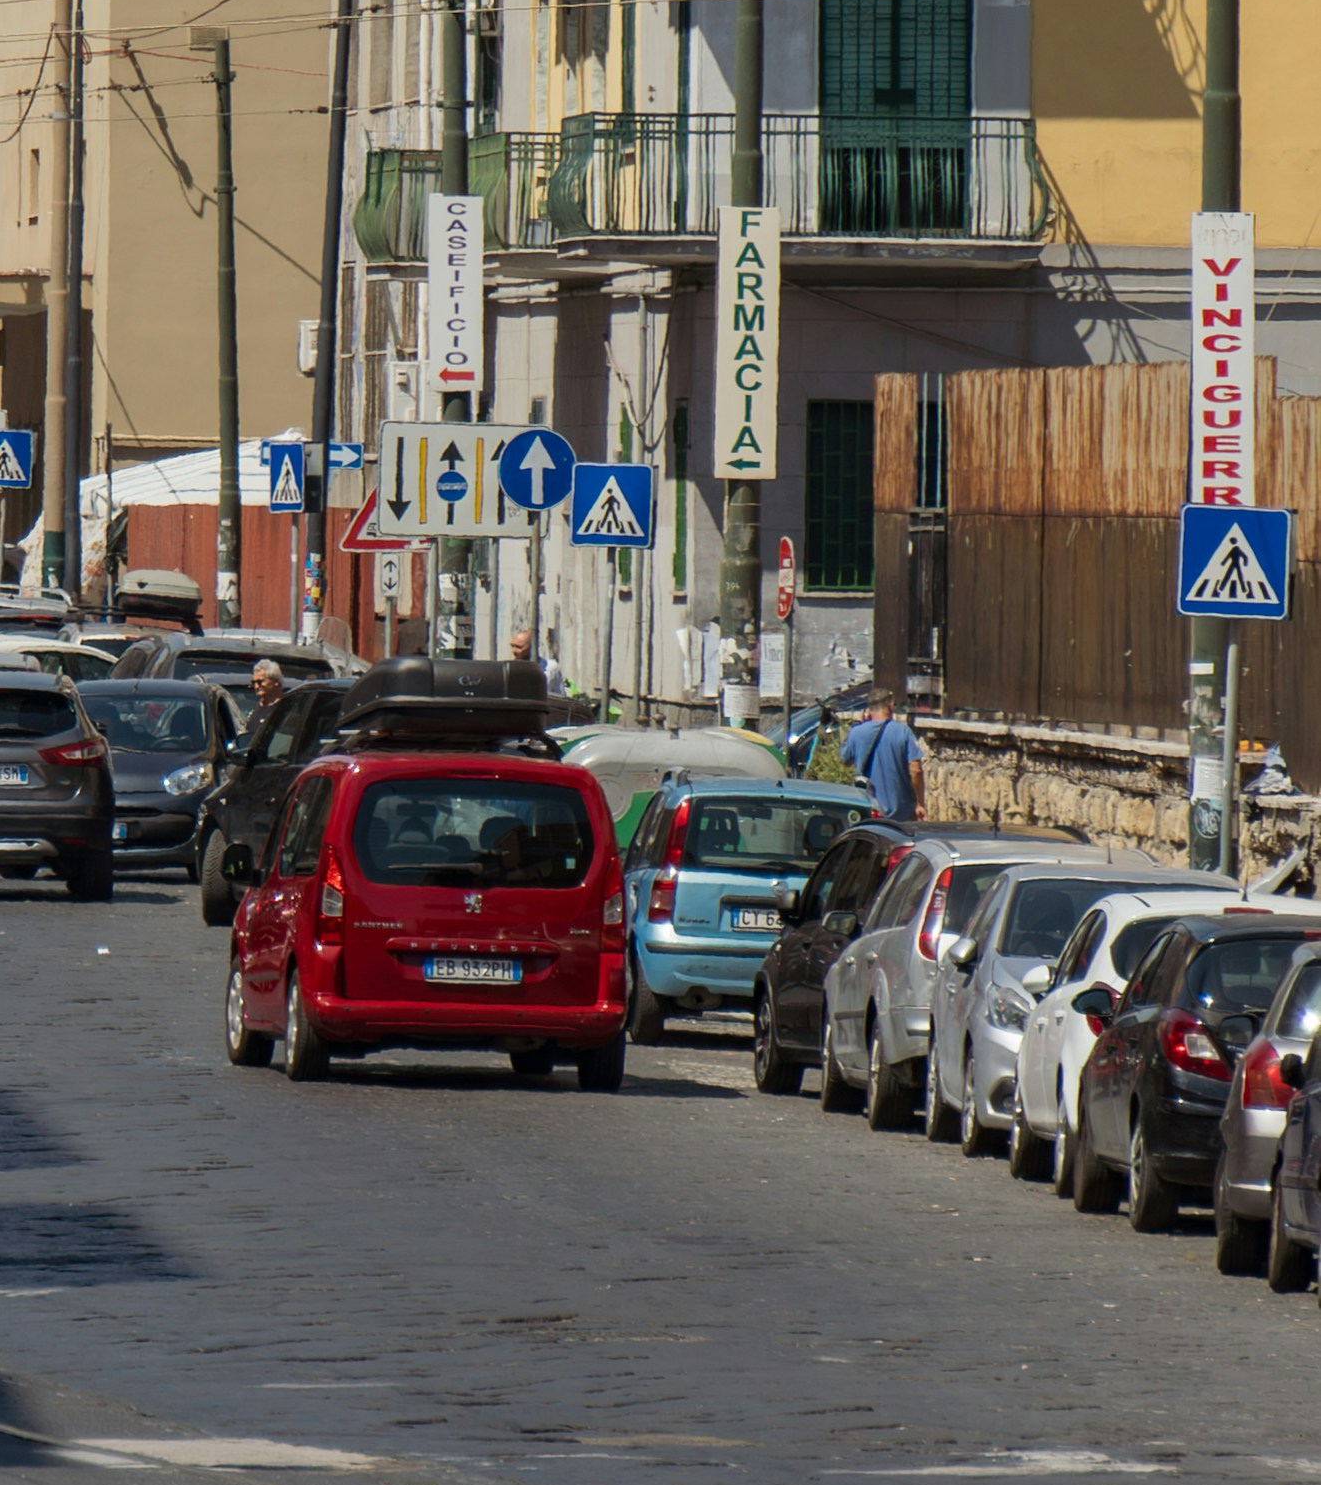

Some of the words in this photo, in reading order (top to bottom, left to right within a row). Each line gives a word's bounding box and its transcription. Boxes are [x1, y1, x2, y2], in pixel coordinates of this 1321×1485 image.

[445, 202, 468, 366] CASEIFICIO
[730, 210, 766, 454] FARMACIA
[742, 910, 760, 926] CY
[435, 957, 456, 976] EB
[462, 958, 512, 979] 932PH
